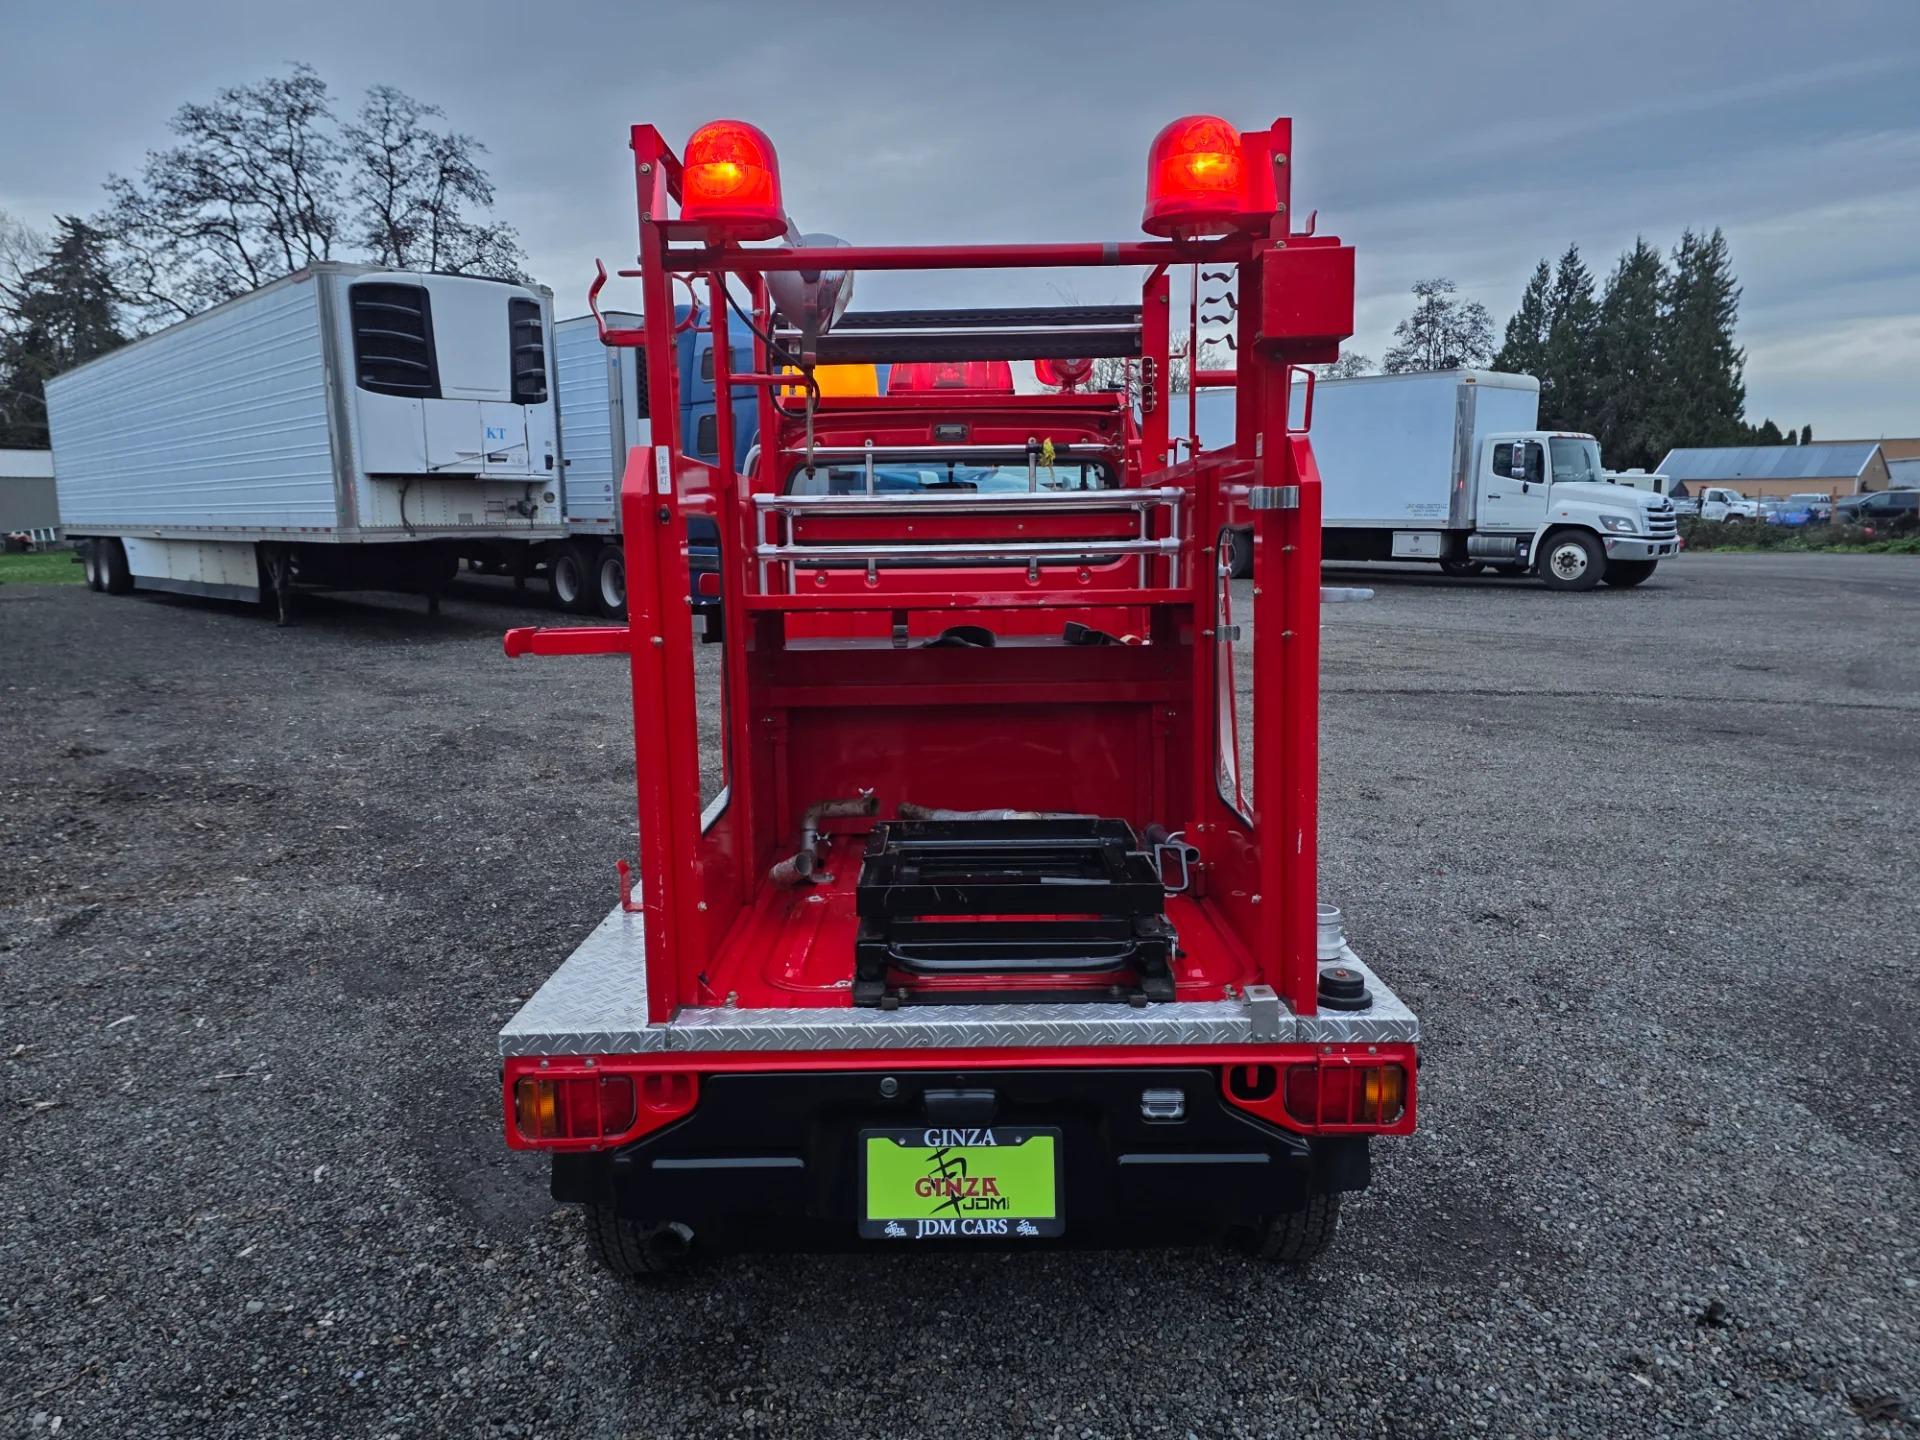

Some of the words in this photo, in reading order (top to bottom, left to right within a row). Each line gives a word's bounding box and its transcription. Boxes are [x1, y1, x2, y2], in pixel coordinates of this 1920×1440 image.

[486, 427, 506, 440] KT
[924, 1128, 997, 1147] GINZA
[915, 1177, 1000, 1198] GINZA
[963, 1197, 1006, 1210] JDM
[915, 1219, 957, 1239] JDM
[961, 1219, 1008, 1235] CARS
